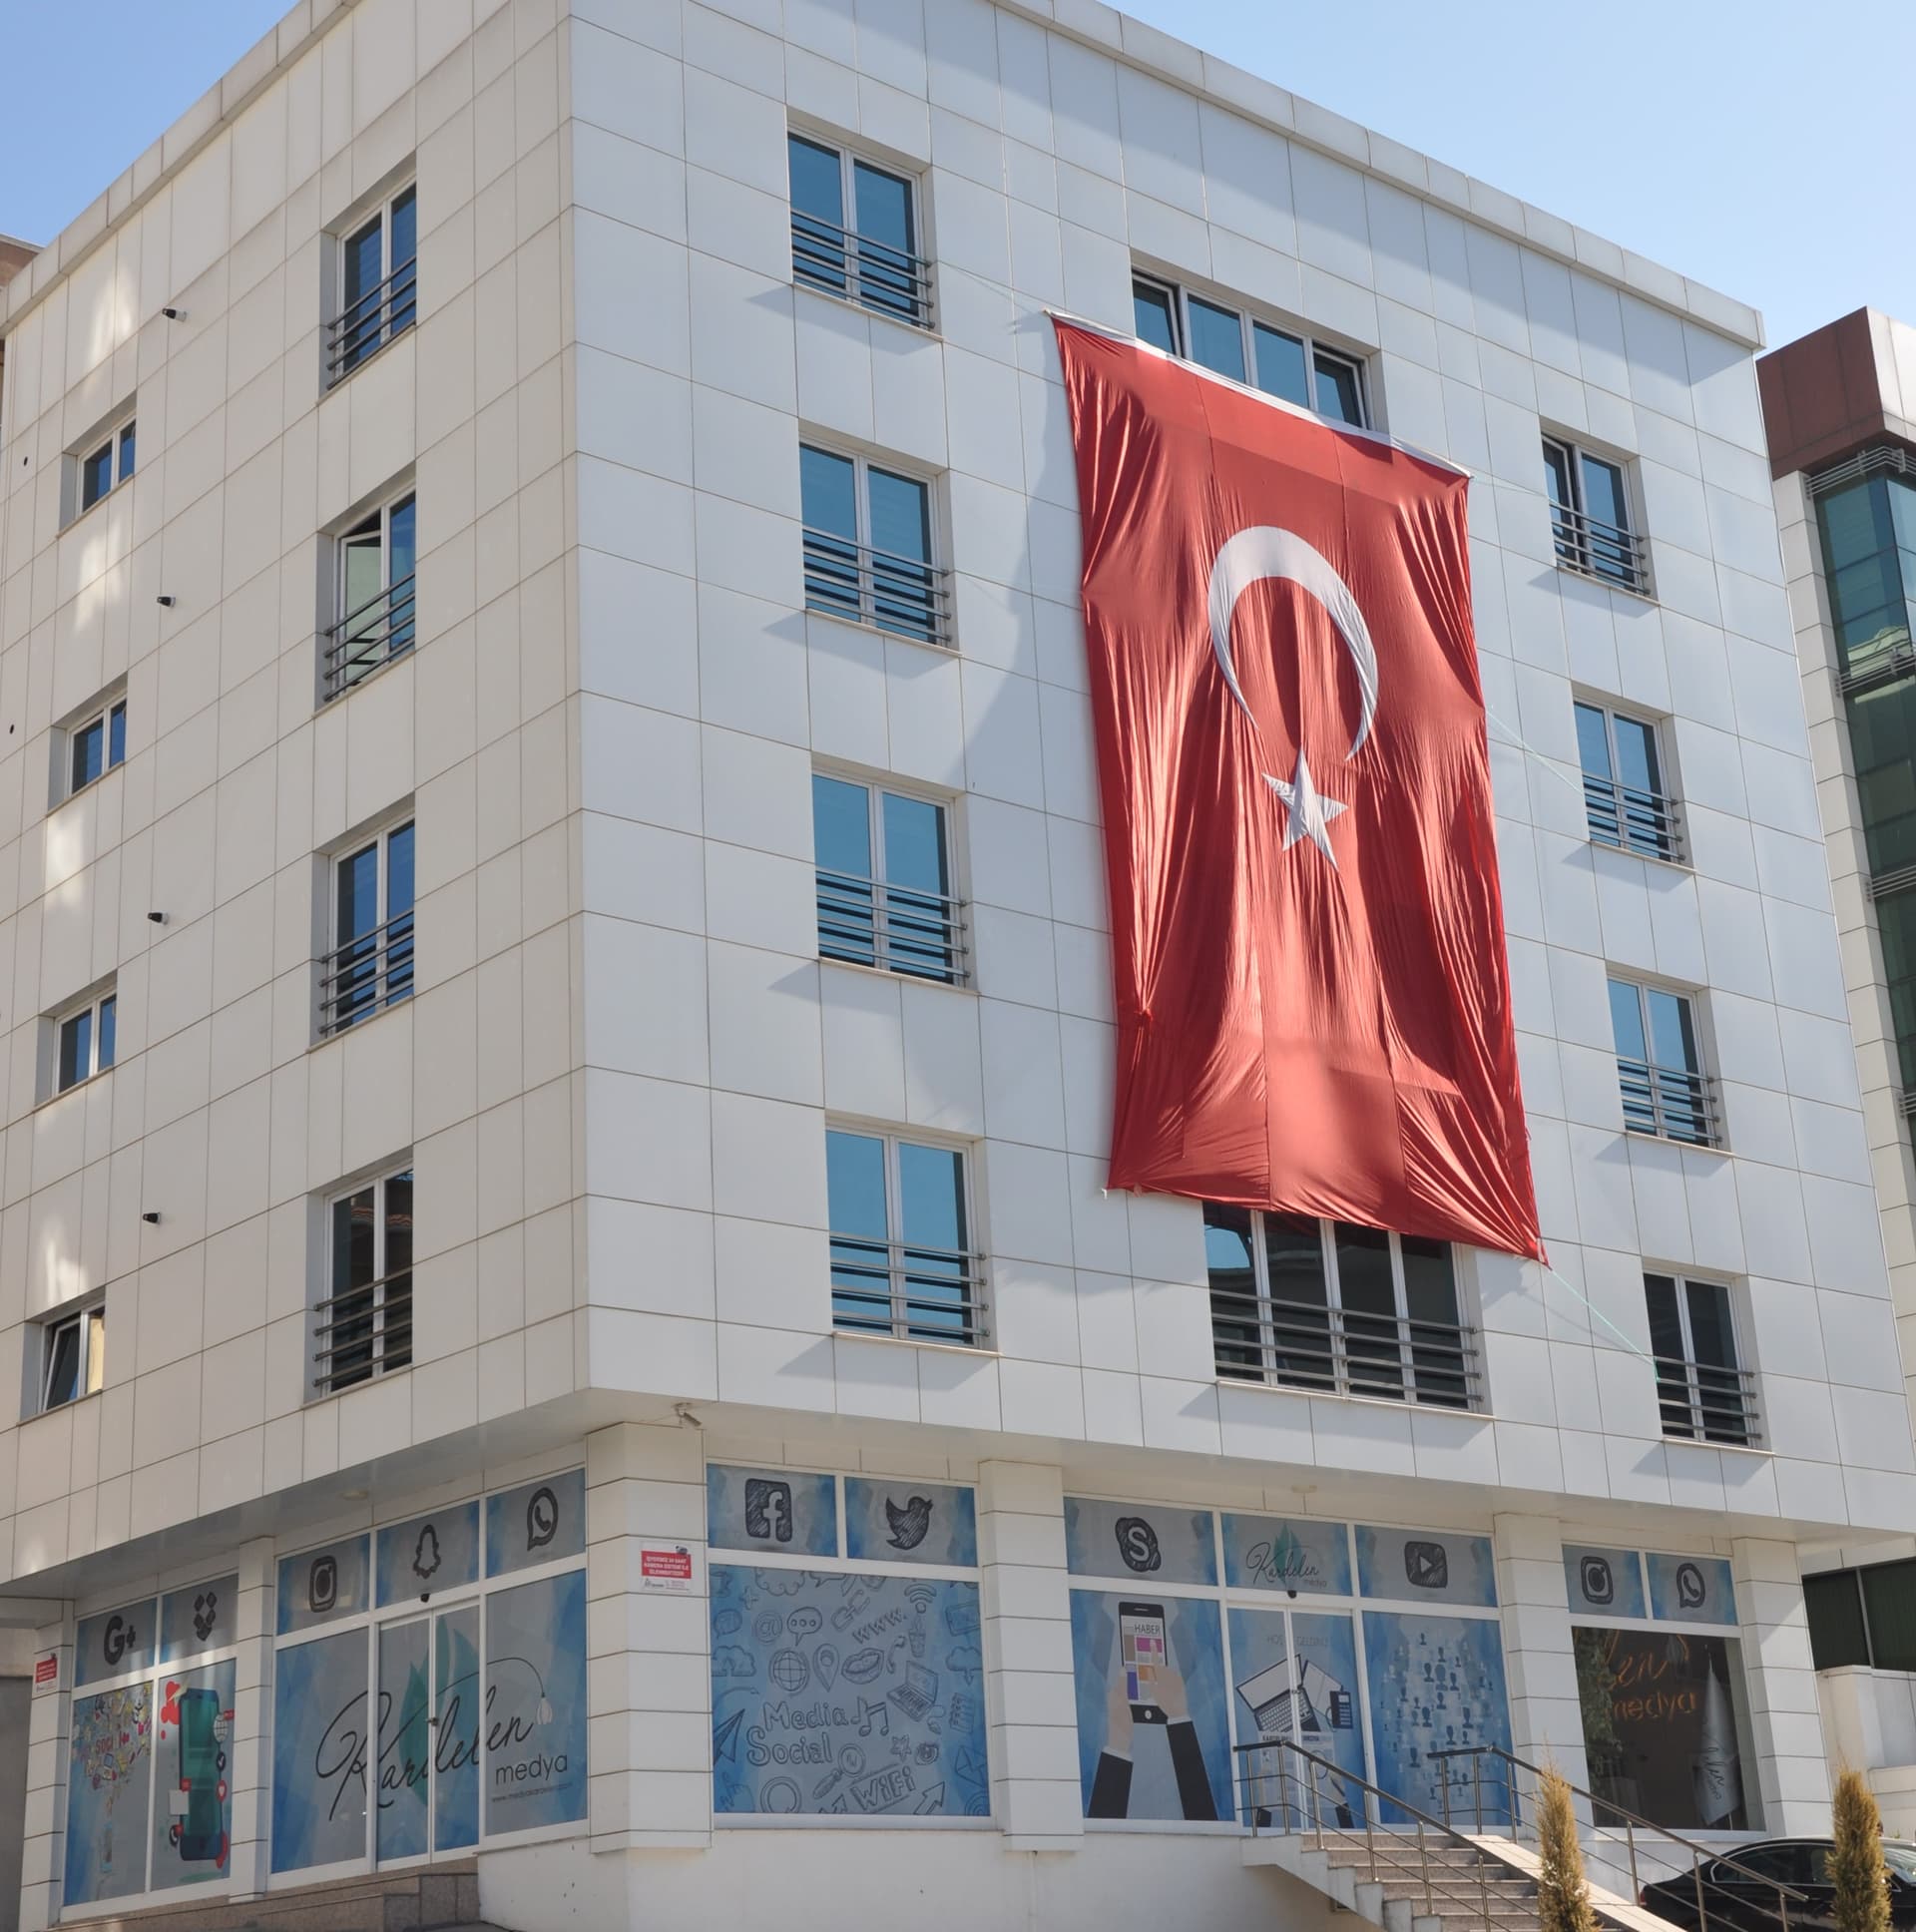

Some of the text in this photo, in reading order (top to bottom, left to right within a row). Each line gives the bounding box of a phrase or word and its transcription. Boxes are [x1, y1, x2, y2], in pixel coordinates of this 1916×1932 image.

[1134, 1624, 1161, 1636] HABER
[762, 1699, 849, 1732] Media
[746, 1724, 834, 1766] Social
[495, 1752, 569, 1786] medya
[850, 1765, 916, 1811] WiFi
